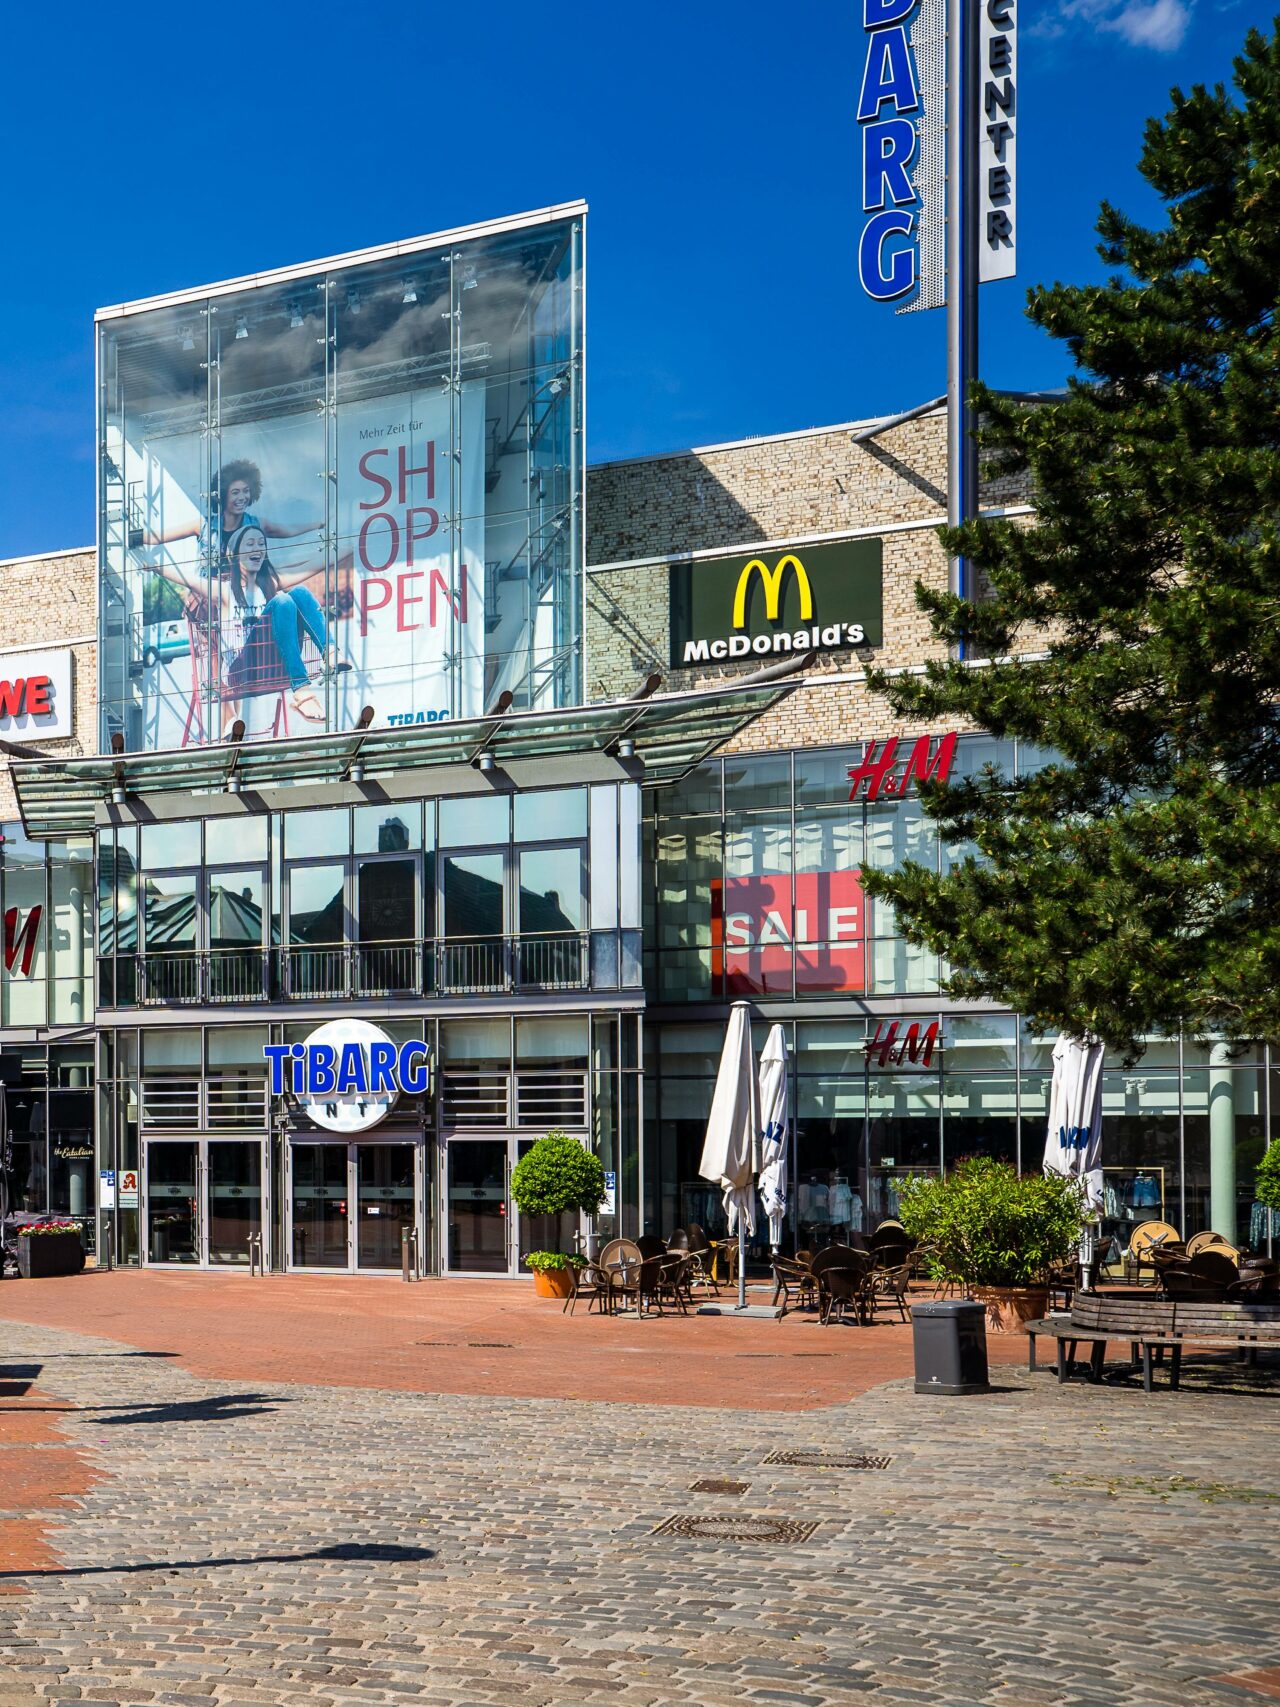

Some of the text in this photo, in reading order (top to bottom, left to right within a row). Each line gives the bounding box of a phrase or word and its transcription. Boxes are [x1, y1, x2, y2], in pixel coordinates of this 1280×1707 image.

[359, 420, 424, 440] Mehr Zeit für
[358, 440, 436, 511] SH
[358, 507, 439, 572] OP
[359, 563, 469, 637] PEN
[682, 622, 865, 664] McDonald's
[847, 731, 958, 801] H&M
[724, 906, 859, 954] SALE
[262, 1039, 429, 1095] TiBARG
[863, 1020, 939, 1068] H&M
